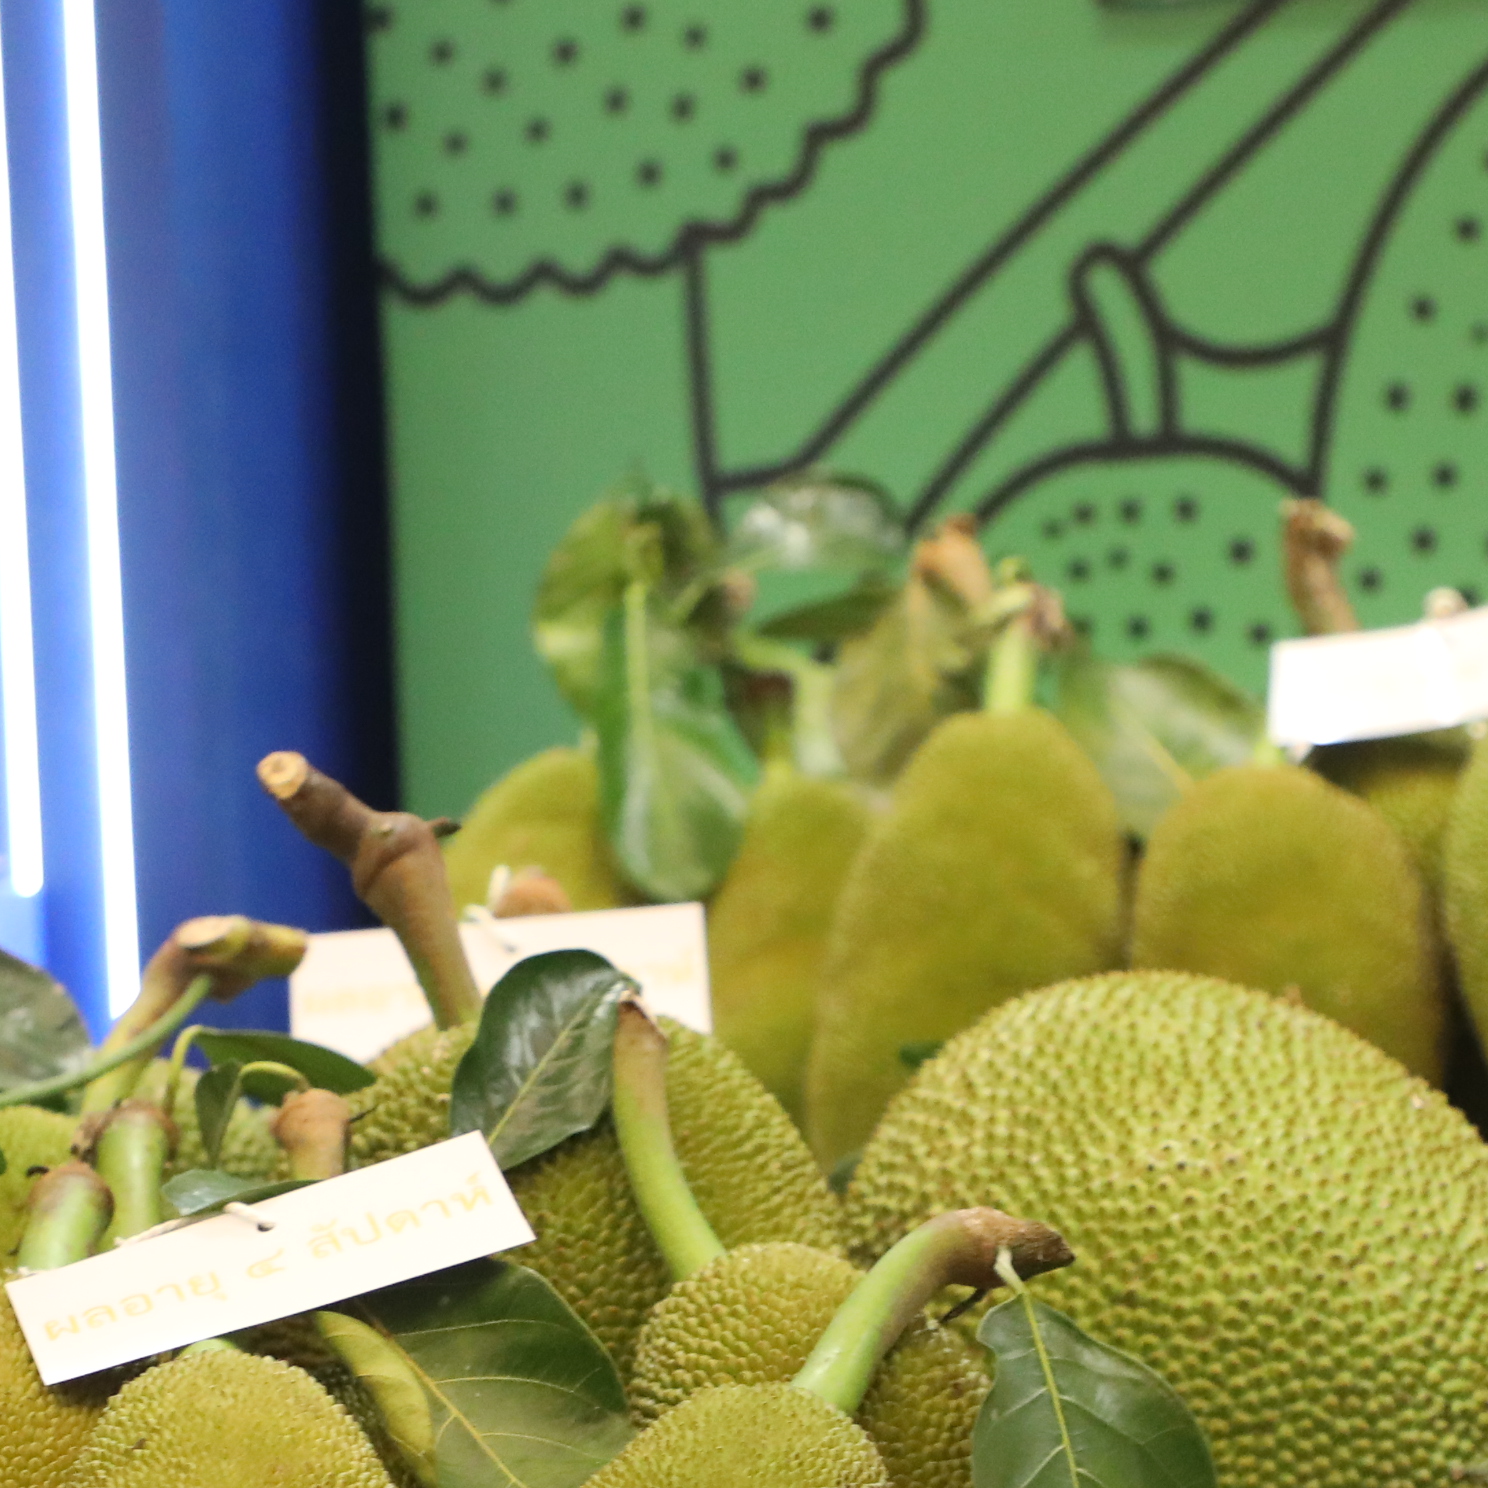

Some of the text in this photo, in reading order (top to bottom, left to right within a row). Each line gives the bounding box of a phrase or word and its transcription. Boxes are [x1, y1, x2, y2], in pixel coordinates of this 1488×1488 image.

[43, 1270, 229, 1343] ผลอายุ
[306, 1171, 493, 1260] สัปดาห์
